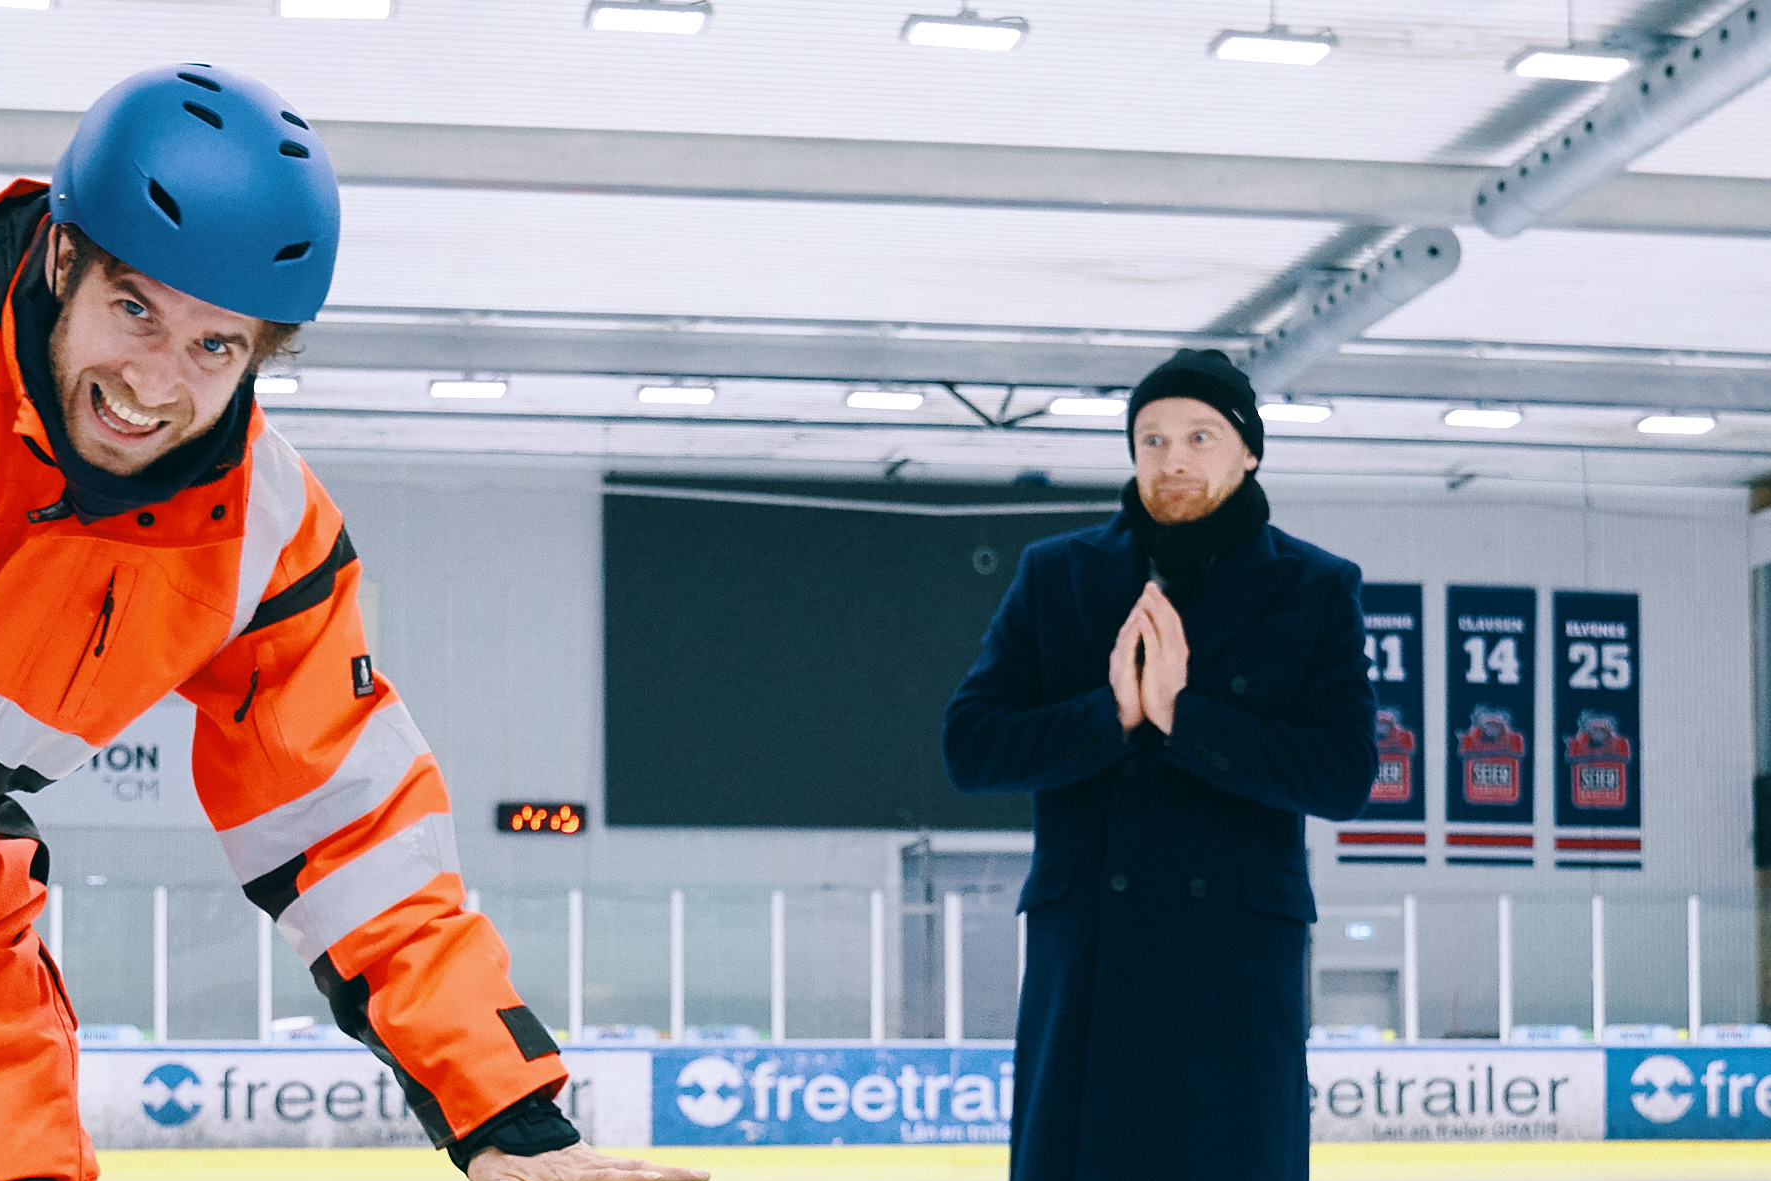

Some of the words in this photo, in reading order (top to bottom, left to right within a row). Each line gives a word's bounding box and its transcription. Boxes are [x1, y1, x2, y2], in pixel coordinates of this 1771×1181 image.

[1463, 635, 1521, 685] 14
[1567, 641, 1632, 691] 25
[751, 1060, 1014, 1123] freetrai
[1309, 1063, 1570, 1119] etrailer
